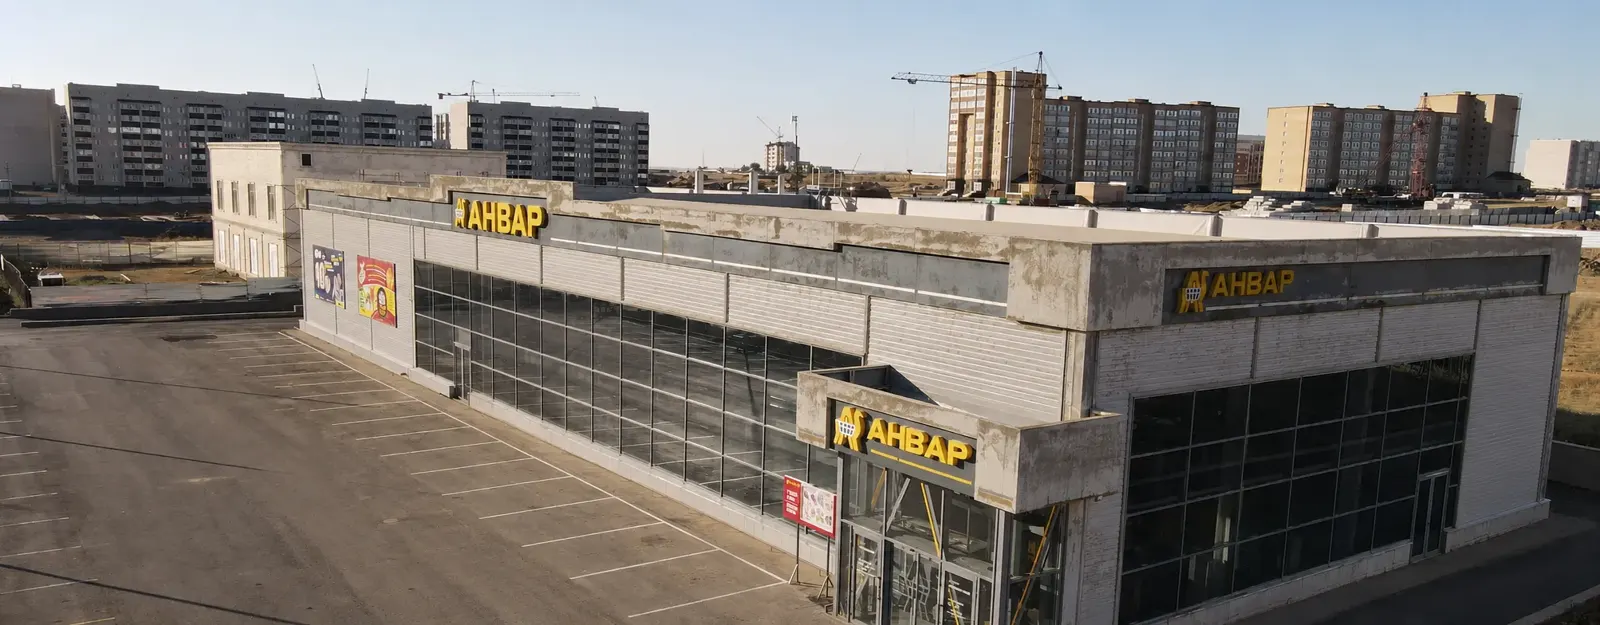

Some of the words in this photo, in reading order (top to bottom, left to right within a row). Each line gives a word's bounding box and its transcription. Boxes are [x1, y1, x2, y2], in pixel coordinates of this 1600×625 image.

[468, 199, 544, 237] АНВАР
[1212, 269, 1295, 298] АНВАР
[867, 418, 969, 466] АНВАР
